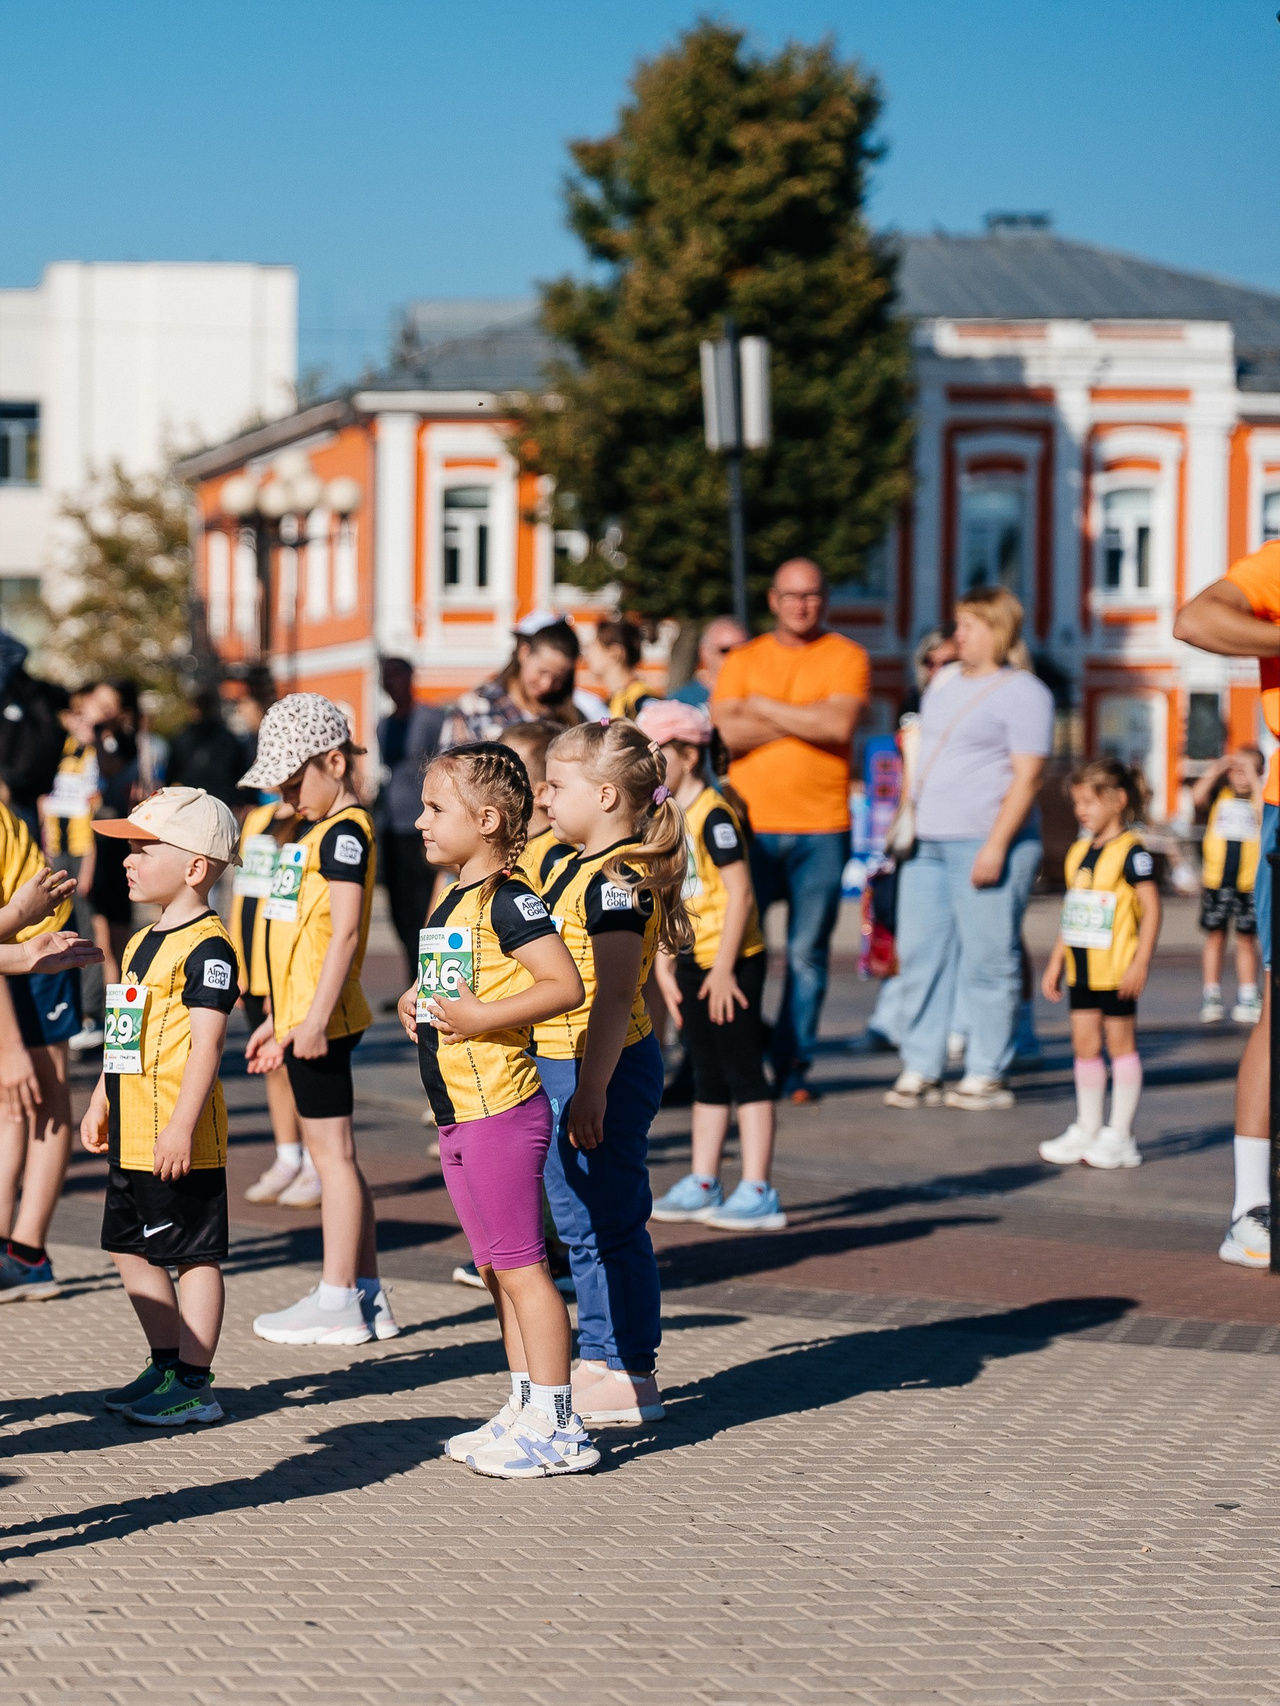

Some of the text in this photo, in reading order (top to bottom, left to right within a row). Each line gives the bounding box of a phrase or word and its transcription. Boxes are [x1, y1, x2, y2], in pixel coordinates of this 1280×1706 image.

[604, 889, 630, 900] Alpen
[521, 899, 543, 911] Alpen
[606, 898, 627, 907] Gold
[526, 907, 545, 917] Gold
[426, 933, 445, 941] ВОРОТА
[207, 967, 229, 979] Alpen
[208, 976, 226, 987] Gold
[520, 1380, 531, 1409] РОШАЯ
